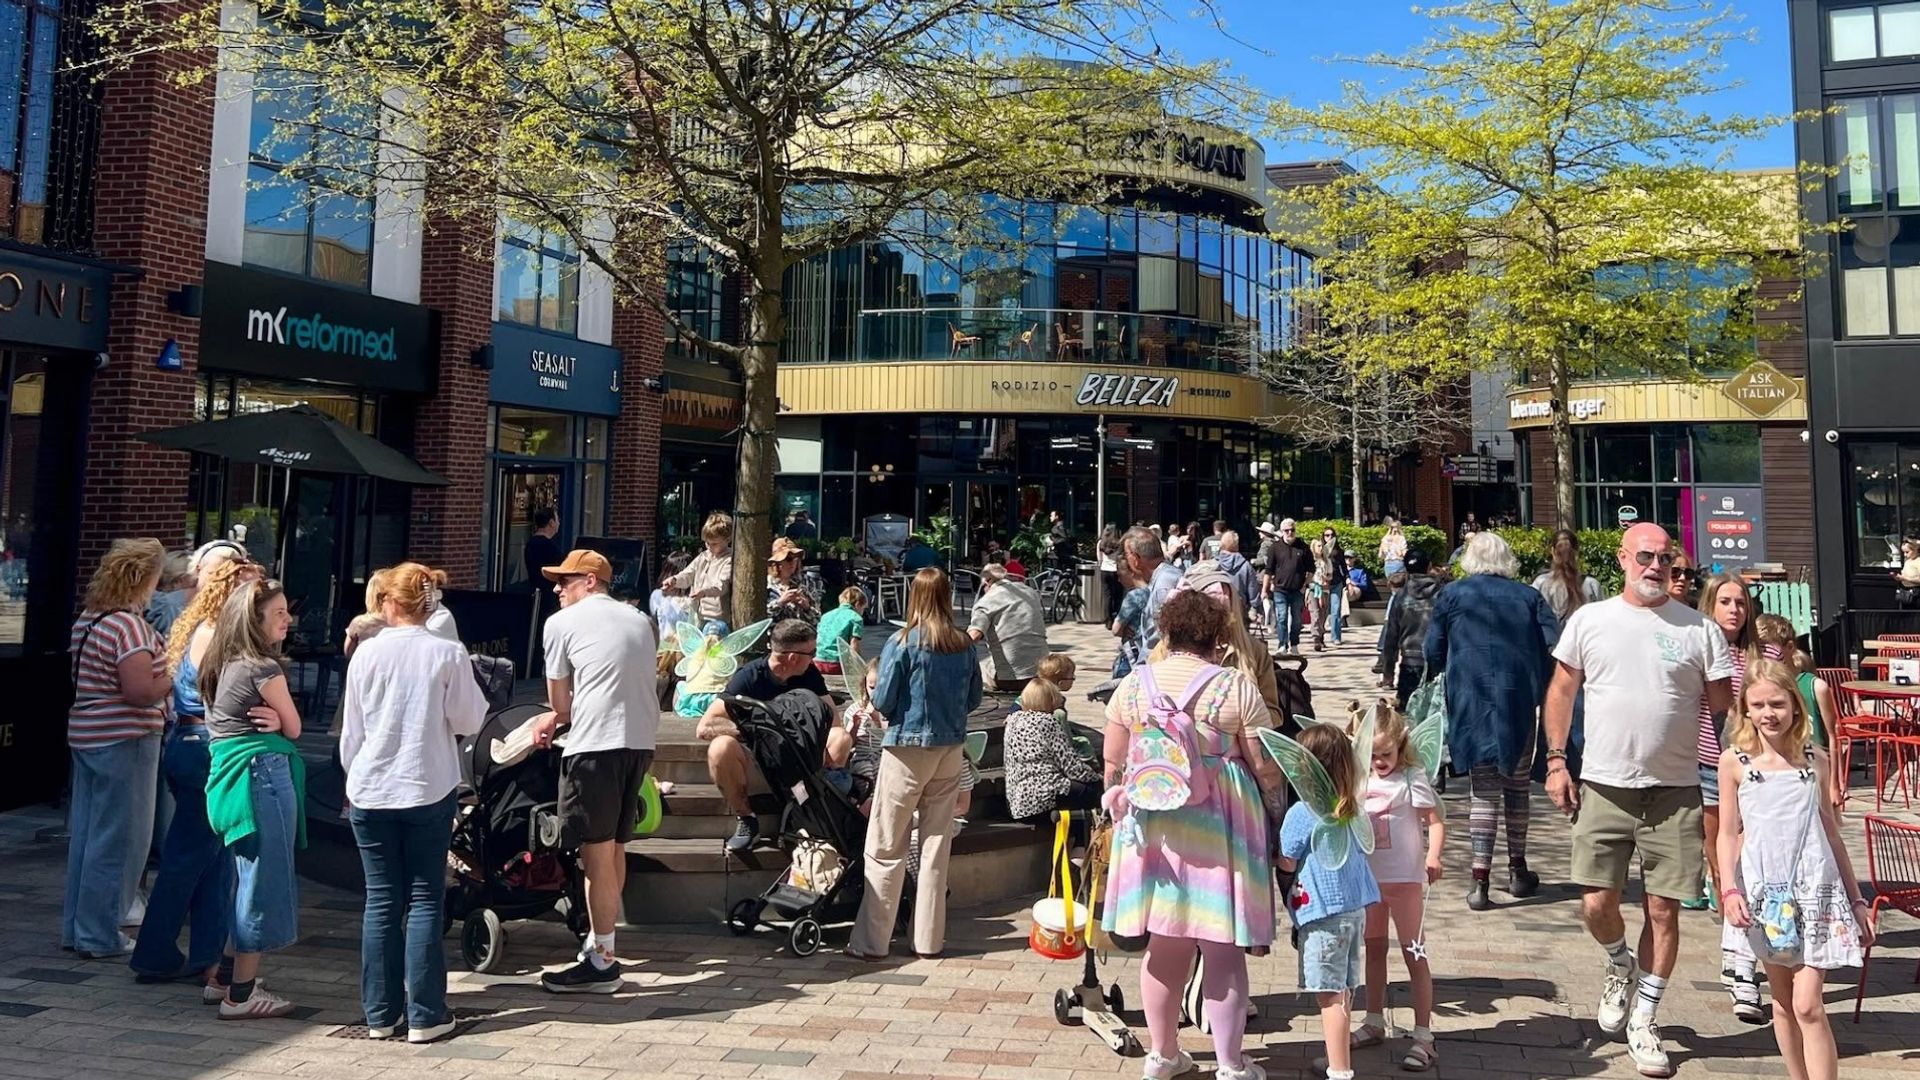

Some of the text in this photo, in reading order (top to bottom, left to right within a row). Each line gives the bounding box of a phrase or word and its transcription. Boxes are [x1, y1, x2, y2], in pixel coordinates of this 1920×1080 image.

[0, 271, 95, 324] ONE
[532, 350, 577, 377] SEASALT
[540, 376, 568, 391] CORNWALL
[1749, 373, 1773, 384] ASK
[991, 372, 1232, 408] RODIZIO BELEZA RODIZIO
[1737, 387, 1785, 399] ITALIAN
[1738, 523, 1748, 531] US
